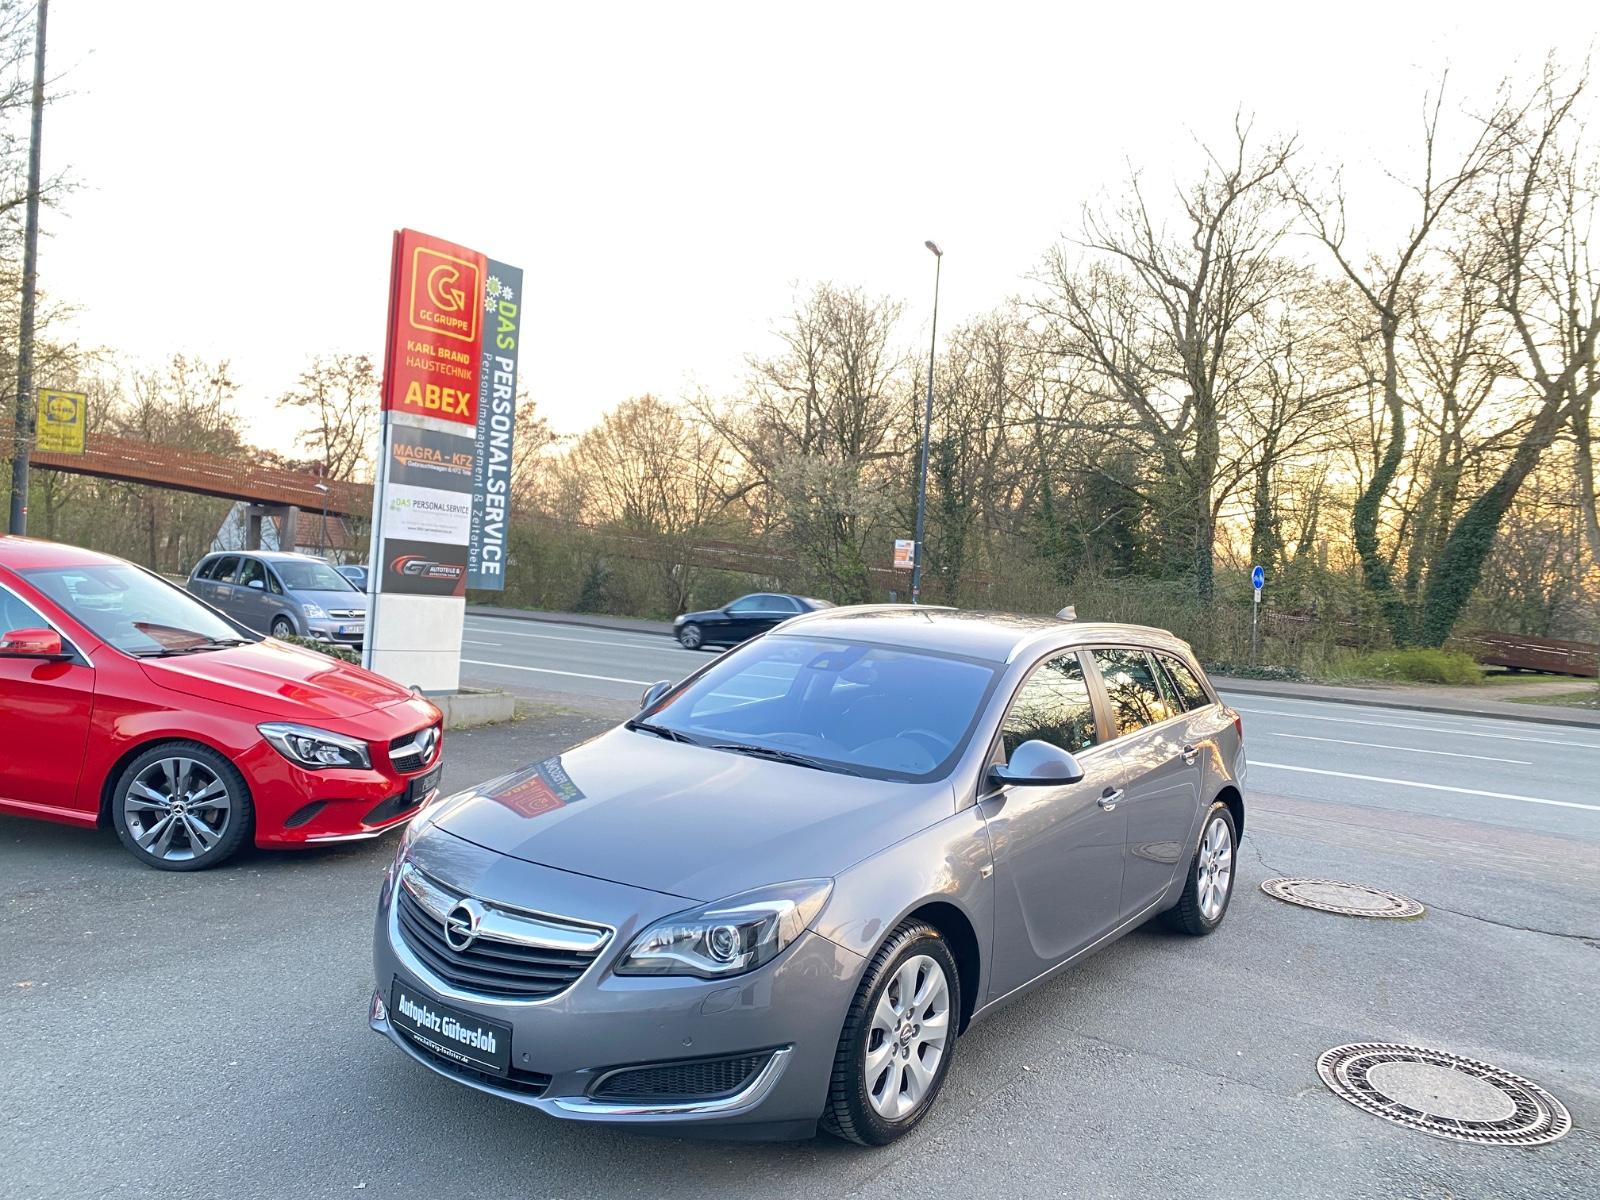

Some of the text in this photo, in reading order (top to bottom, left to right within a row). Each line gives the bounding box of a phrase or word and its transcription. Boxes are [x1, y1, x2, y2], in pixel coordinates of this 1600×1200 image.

[420, 309, 468, 331] GC GRUPPE
[407, 340, 470, 365] KARL BRAND
[406, 356, 472, 381] HAUSTECHNIK
[404, 381, 471, 416] ABEX
[474, 352, 493, 487] Personalmanagement
[481, 300, 517, 575] DAS PERSONALSERVICE
[393, 443, 442, 461] MAGRA
[452, 453, 473, 467] KFZ
[396, 498, 411, 507] DAS
[412, 500, 470, 515] PERSONALSERVICE
[469, 510, 483, 573] Zeitarbeit
[398, 994, 496, 1054] Autoplatz Gütersloh
